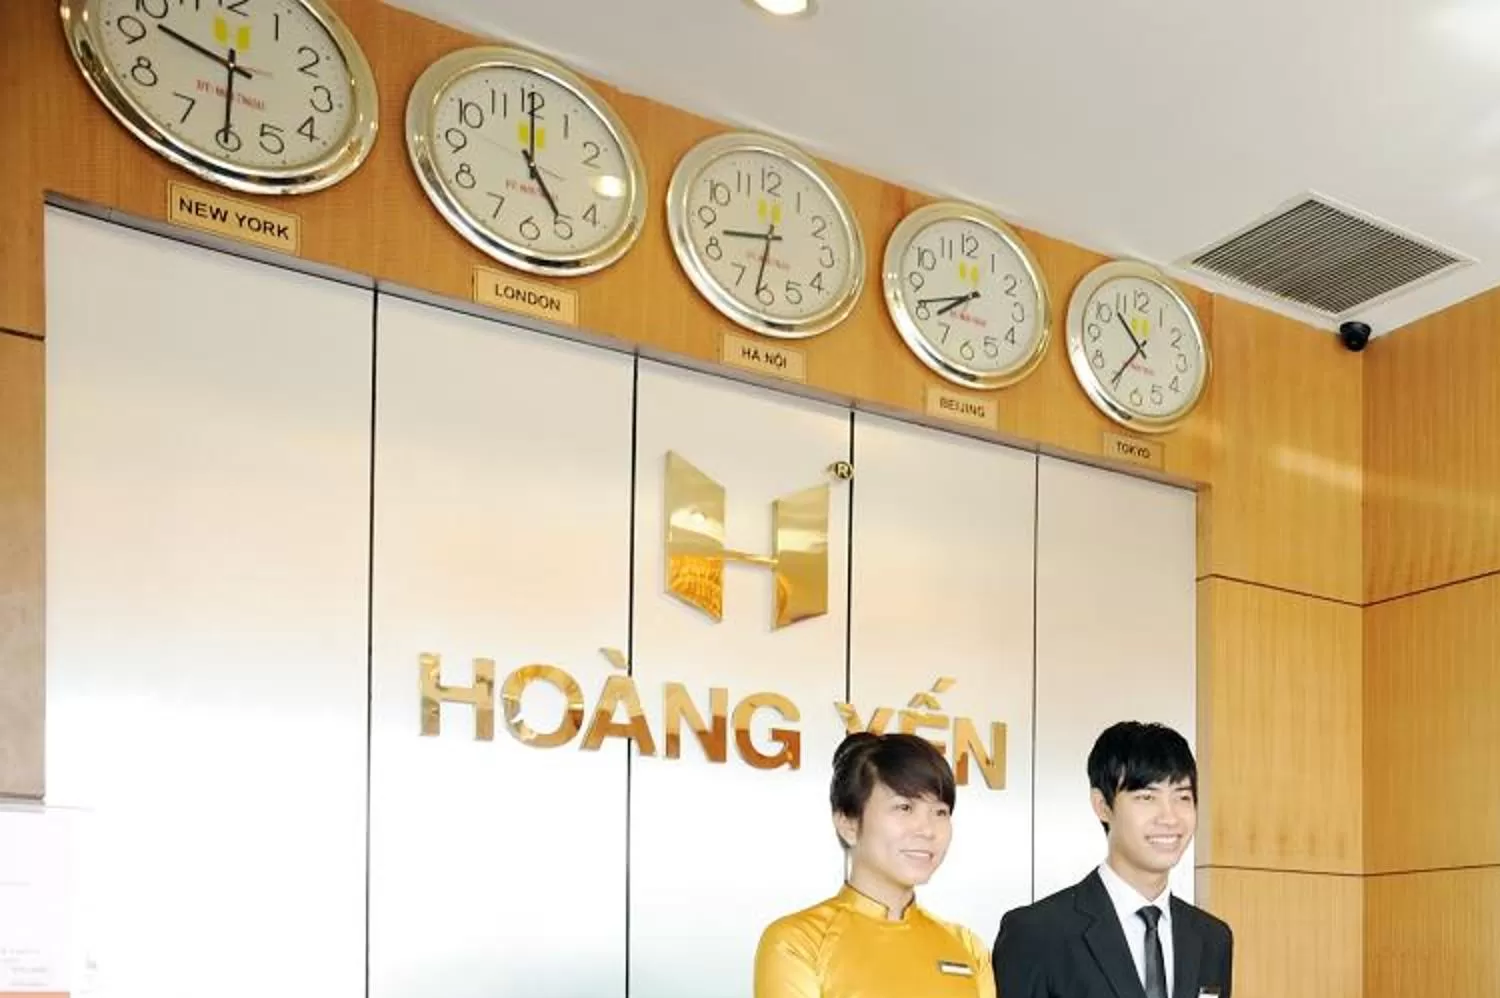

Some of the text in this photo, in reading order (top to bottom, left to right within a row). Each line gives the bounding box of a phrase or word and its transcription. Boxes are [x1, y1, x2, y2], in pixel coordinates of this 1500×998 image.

[117, 15, 147, 45] 9
[272, 13, 280, 41] 1
[131, 55, 158, 87] 8
[297, 46, 320, 78] 2
[172, 92, 196, 123] 7
[310, 85, 333, 113] 3
[491, 88, 507, 119] 11
[521, 87, 545, 120] 12
[459, 98, 484, 129] 10
[259, 123, 285, 154] 5
[297, 116, 319, 143] 4
[562, 113, 569, 140] 1
[445, 127, 467, 154] 9
[581, 141, 601, 169] 2
[455, 163, 477, 189] 8
[737, 170, 751, 198] 11
[761, 168, 782, 197] 12
[486, 191, 505, 219] 7
[704, 179, 731, 206] 10
[796, 192, 802, 213] 1
[179, 196, 289, 240] NEW YORK
[519, 215, 541, 241] 6
[554, 213, 573, 240] 5
[582, 204, 599, 227] 4
[698, 205, 717, 229] 9
[811, 215, 827, 241] 2
[705, 236, 723, 261] 8
[819, 246, 835, 269] 3
[917, 247, 936, 271] 10
[941, 236, 953, 260] 11
[961, 234, 979, 259] 12
[730, 262, 747, 287] 7
[809, 272, 824, 294] 4
[909, 271, 924, 292] 9
[1004, 274, 1017, 297] 2
[495, 283, 561, 312] LONDON
[756, 283, 775, 306] 6
[785, 280, 803, 305] 5
[1116, 292, 1126, 313] 11
[1133, 289, 1150, 313] 12
[1012, 302, 1025, 322] 3
[1096, 301, 1113, 323] 10
[938, 321, 950, 344] 7
[1004, 327, 1015, 345] 4
[1088, 323, 1100, 342] 9
[1170, 327, 1182, 350] 2
[960, 340, 975, 360] 6
[984, 336, 998, 358] 5
[1092, 350, 1105, 369] 8
[1176, 353, 1188, 373] 3
[1150, 384, 1164, 405] 5
[1168, 375, 1180, 393] 4
[940, 396, 985, 417] BEIJING
[1130, 388, 1143, 406] 6
[1117, 441, 1151, 459] TOKYO
[418, 647, 801, 771] HOÀNG
